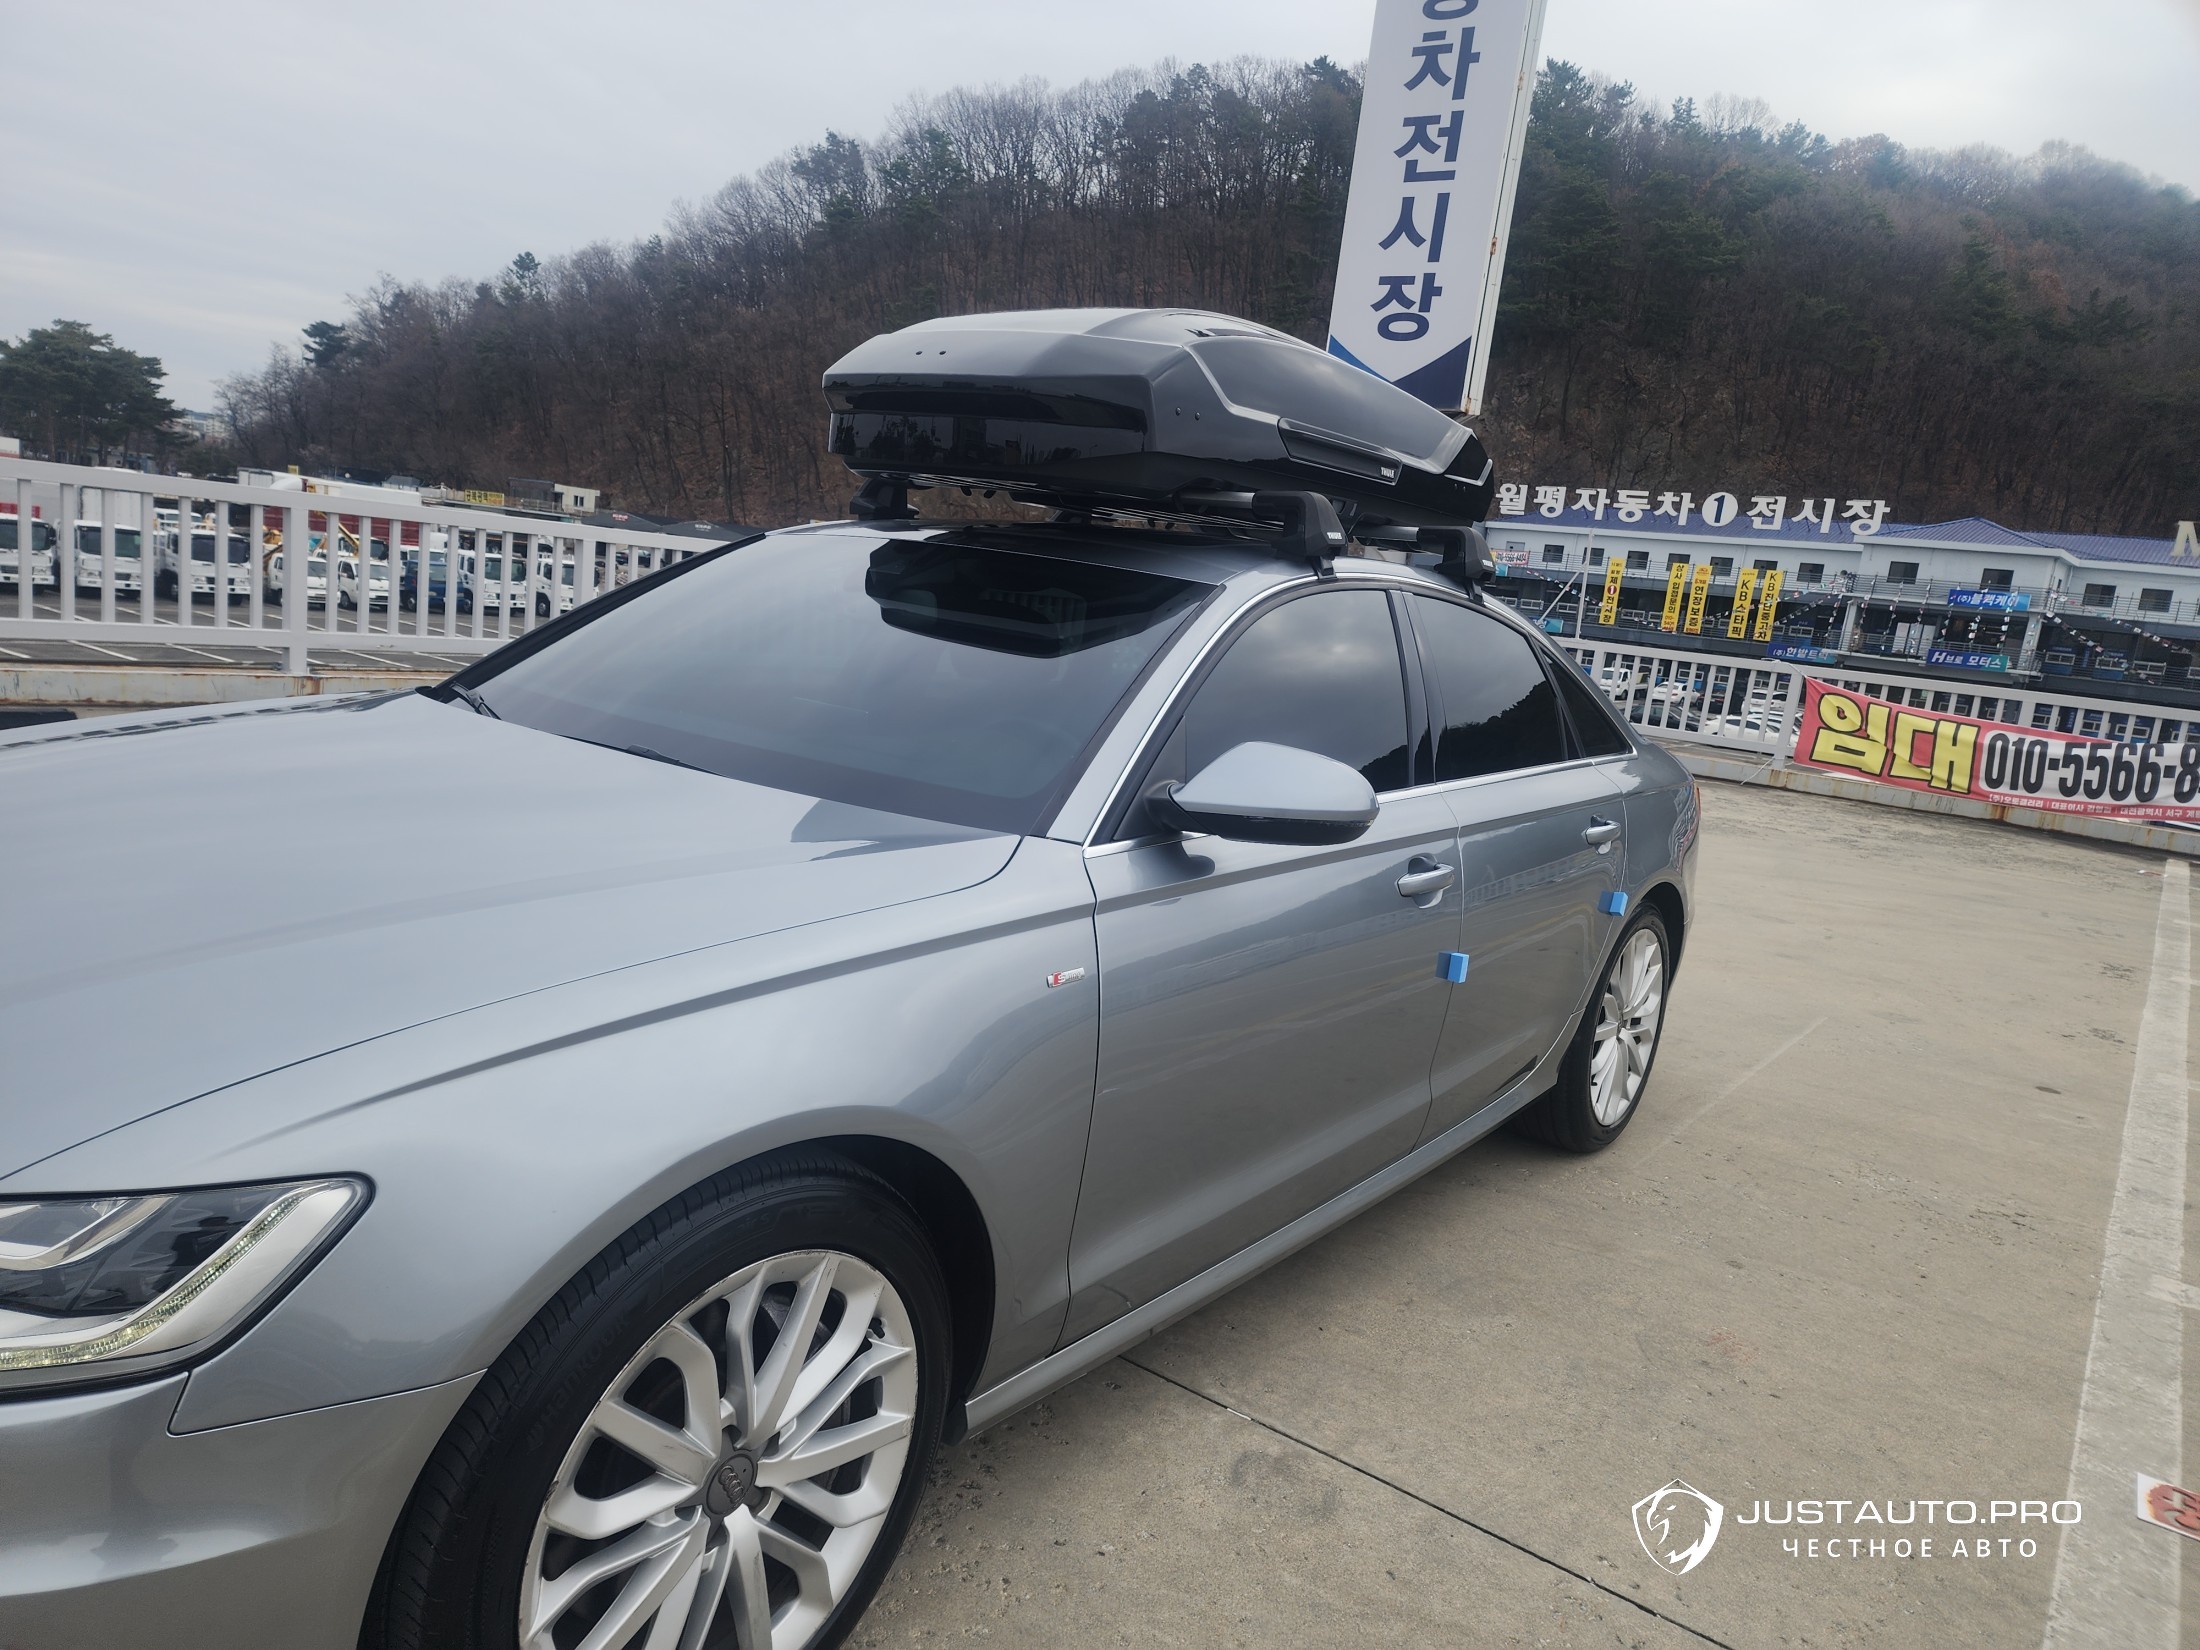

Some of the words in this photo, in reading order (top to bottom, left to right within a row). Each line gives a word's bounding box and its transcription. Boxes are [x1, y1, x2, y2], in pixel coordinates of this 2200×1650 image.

[1370, 0, 1481, 342] 차전시장
[1745, 495, 1891, 536] 전시장
[1809, 692, 1981, 795] 임대
[1984, 732, 2200, 804] 010-5566-8
